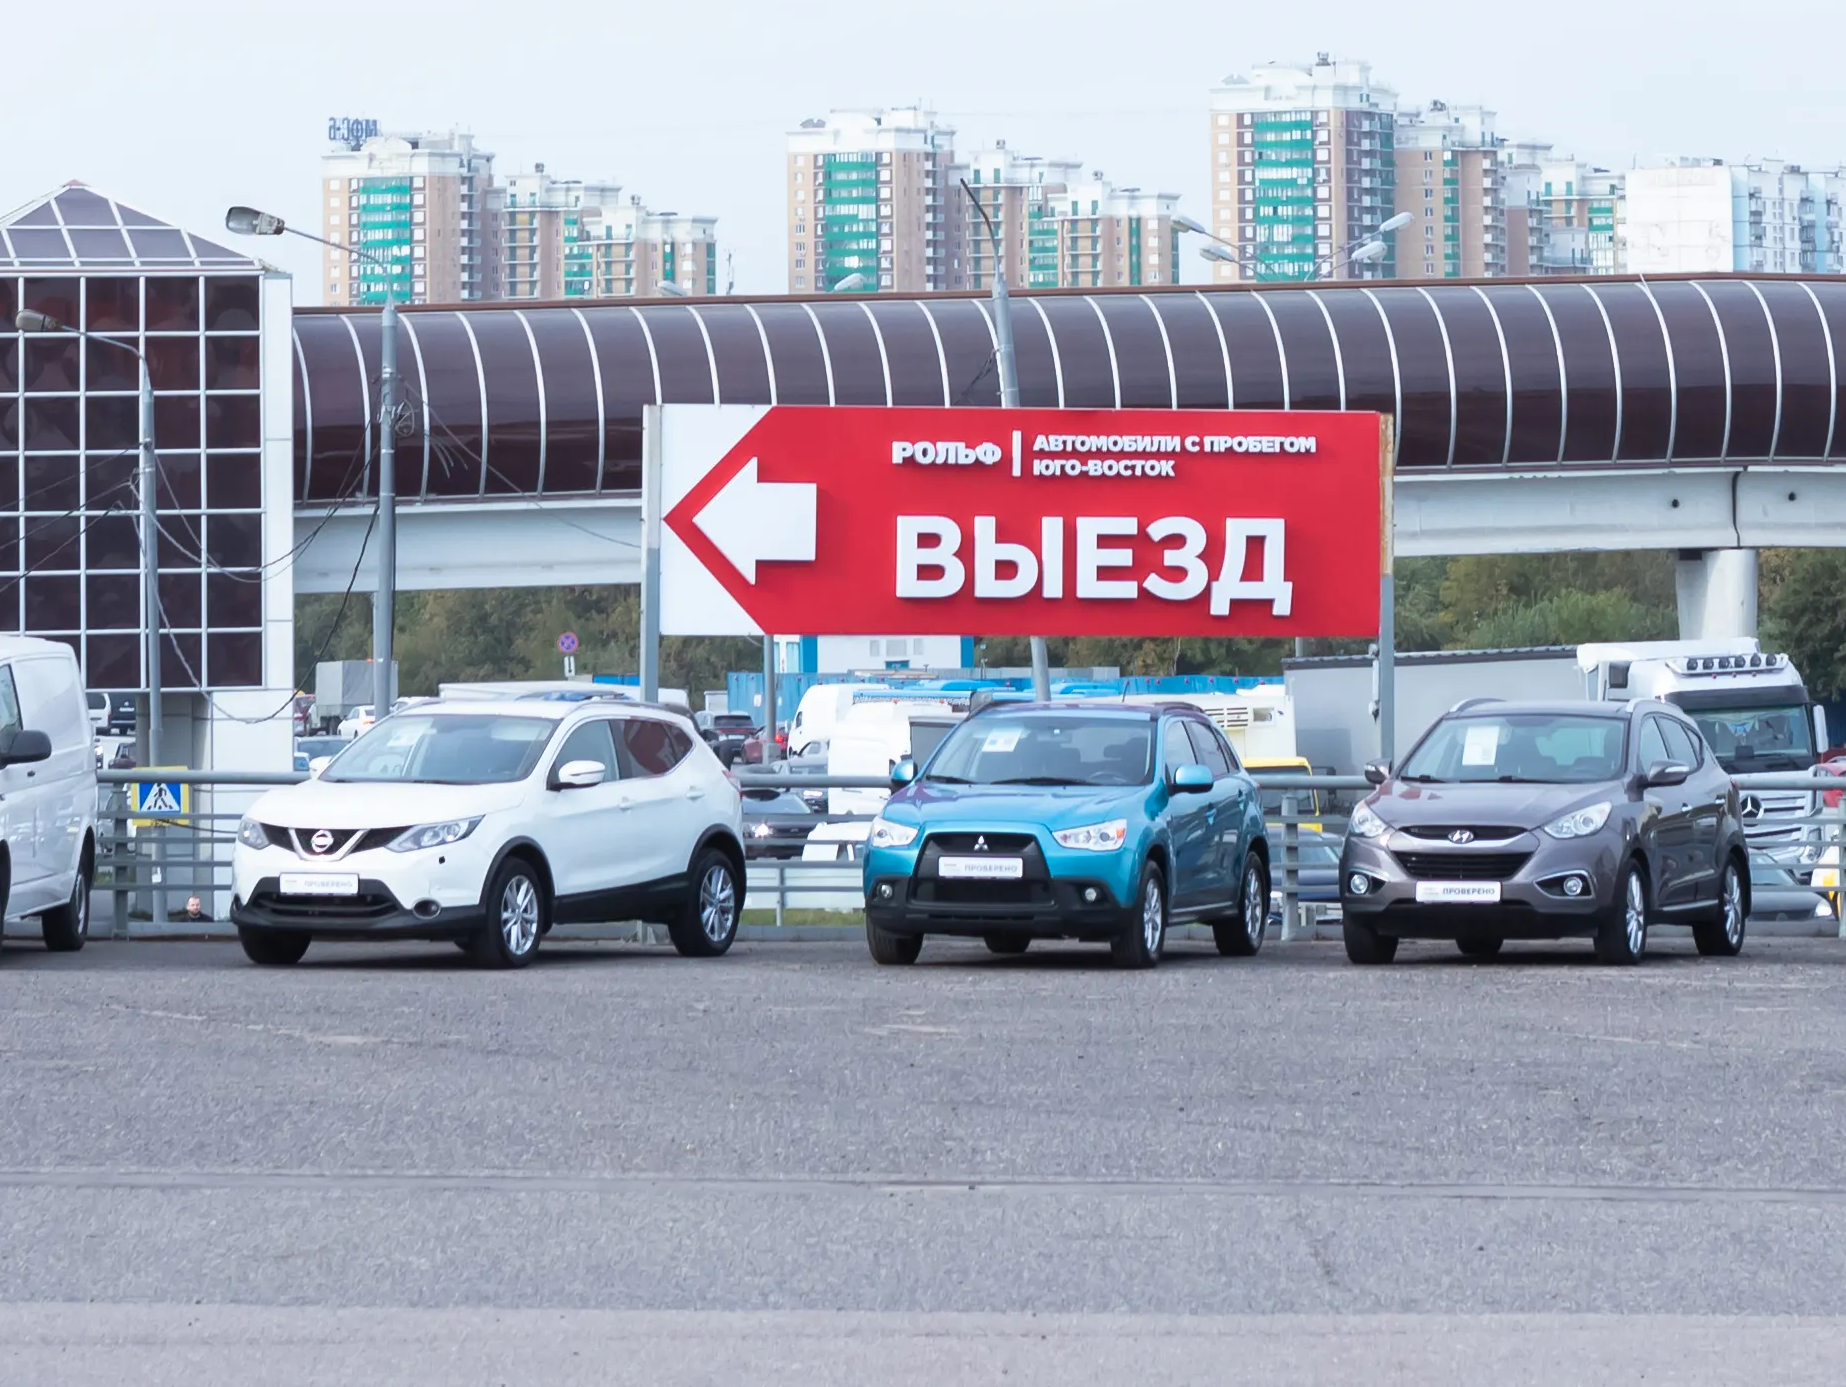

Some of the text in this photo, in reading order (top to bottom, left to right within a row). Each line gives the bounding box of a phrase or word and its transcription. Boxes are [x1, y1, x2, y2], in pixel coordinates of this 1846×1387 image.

[892, 434, 1317, 466] РОЛЬФ АВТОМОБИЛИ С ПРОБЕГОМ
[1032, 459, 1176, 478] ЮГО-ВОСТОК
[895, 515, 1293, 617] ВЫЕЗД
[965, 863, 1018, 872] ПРОВЕРЕНО
[1443, 887, 1496, 895] ПРОВЕРЕНО
